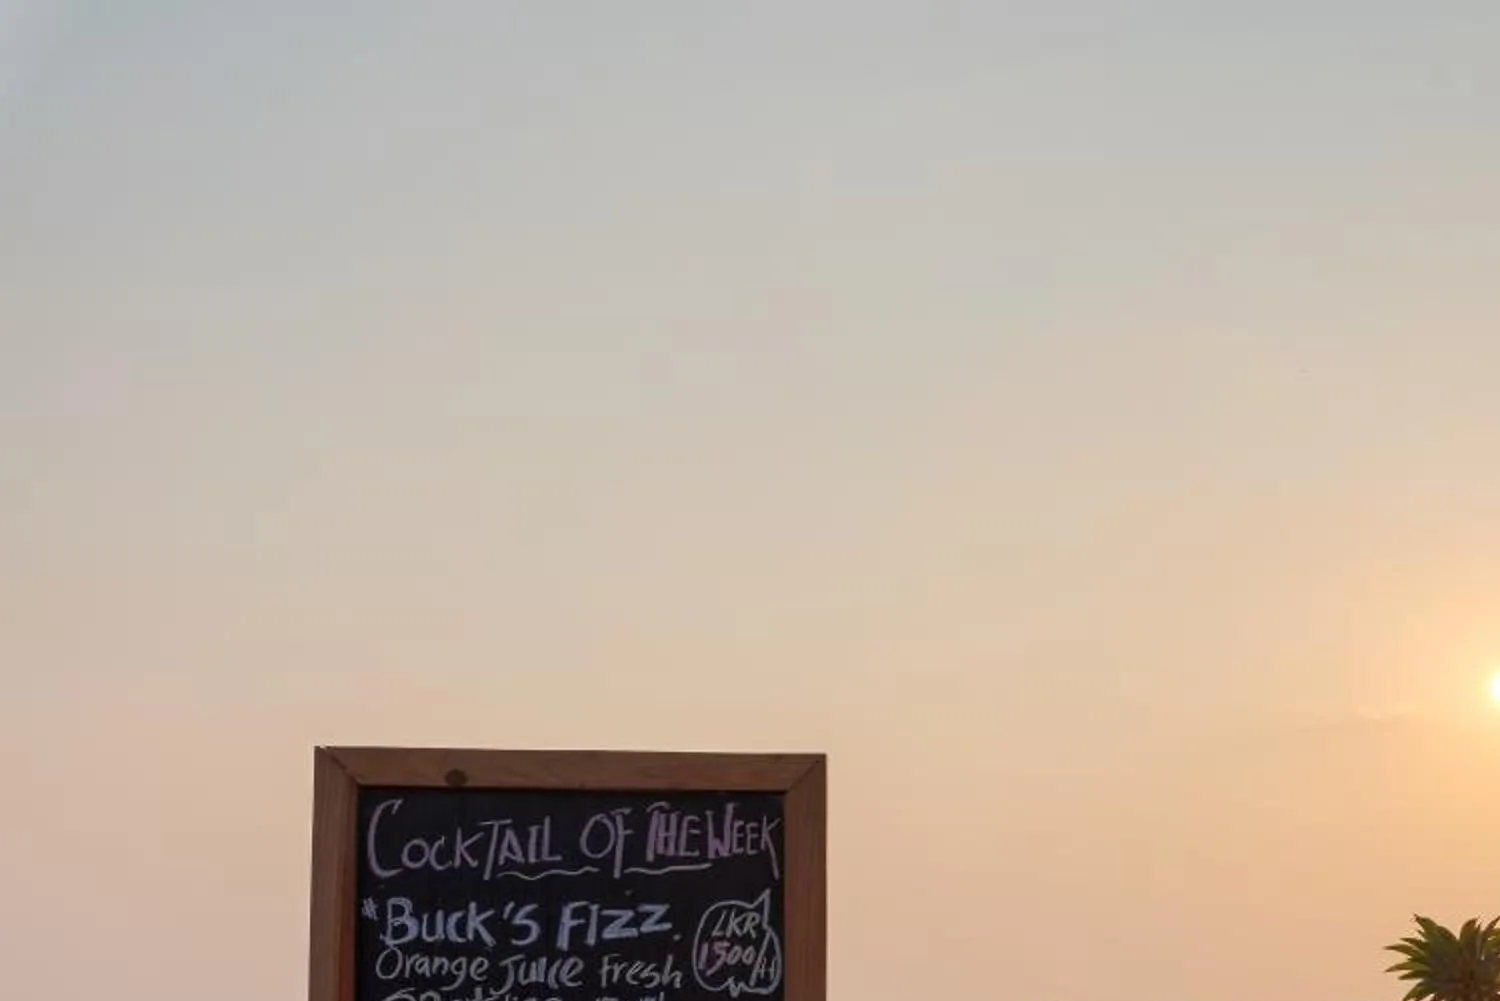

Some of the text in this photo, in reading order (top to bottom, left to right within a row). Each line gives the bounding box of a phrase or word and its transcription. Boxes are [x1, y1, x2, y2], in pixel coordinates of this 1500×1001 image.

[580, 807, 633, 879] OF
[646, 801, 700, 862] THE
[705, 802, 781, 880] WEEK
[711, 908, 762, 939] LKR
[376, 946, 488, 990] Orange
[600, 953, 682, 989] Fresh
